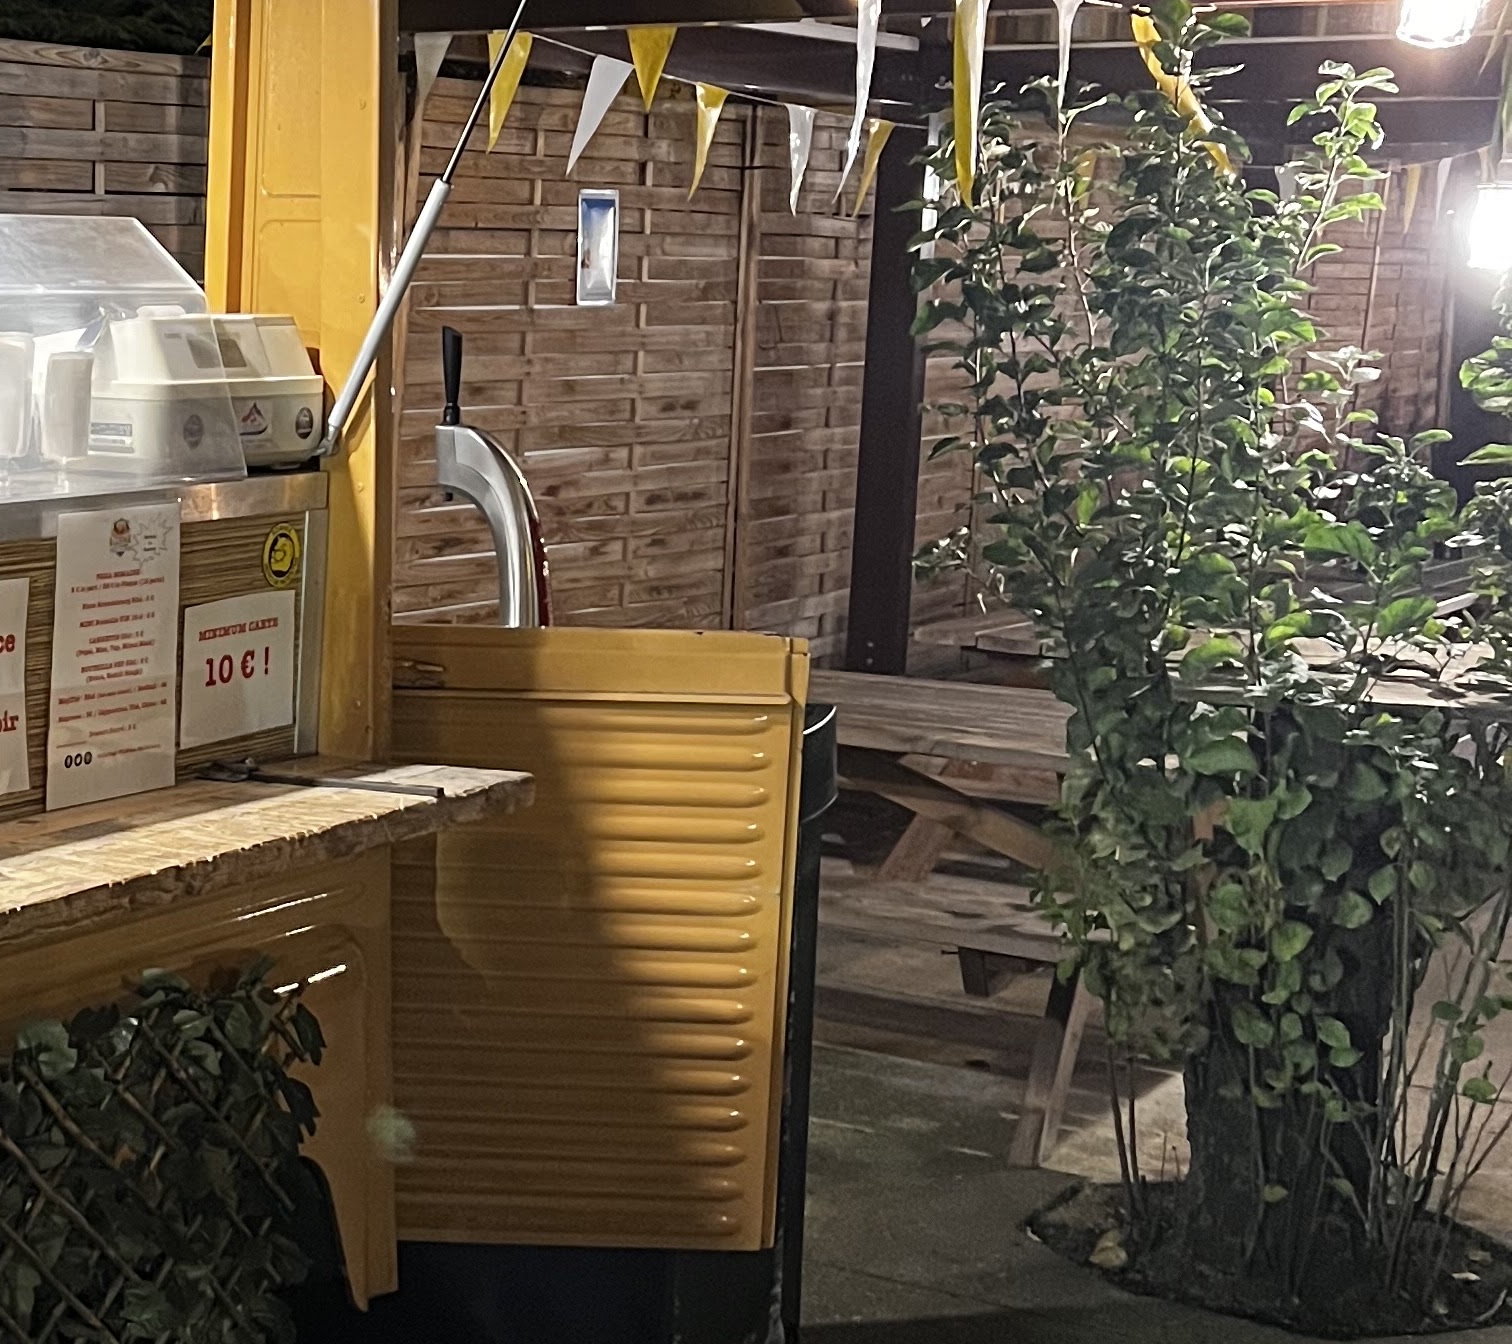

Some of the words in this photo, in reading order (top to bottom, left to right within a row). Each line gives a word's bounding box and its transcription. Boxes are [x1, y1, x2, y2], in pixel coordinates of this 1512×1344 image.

[198, 622, 247, 642] MINIMUM
[205, 654, 234, 687] 10
[241, 649, 255, 679] €
[264, 646, 270, 675] !
